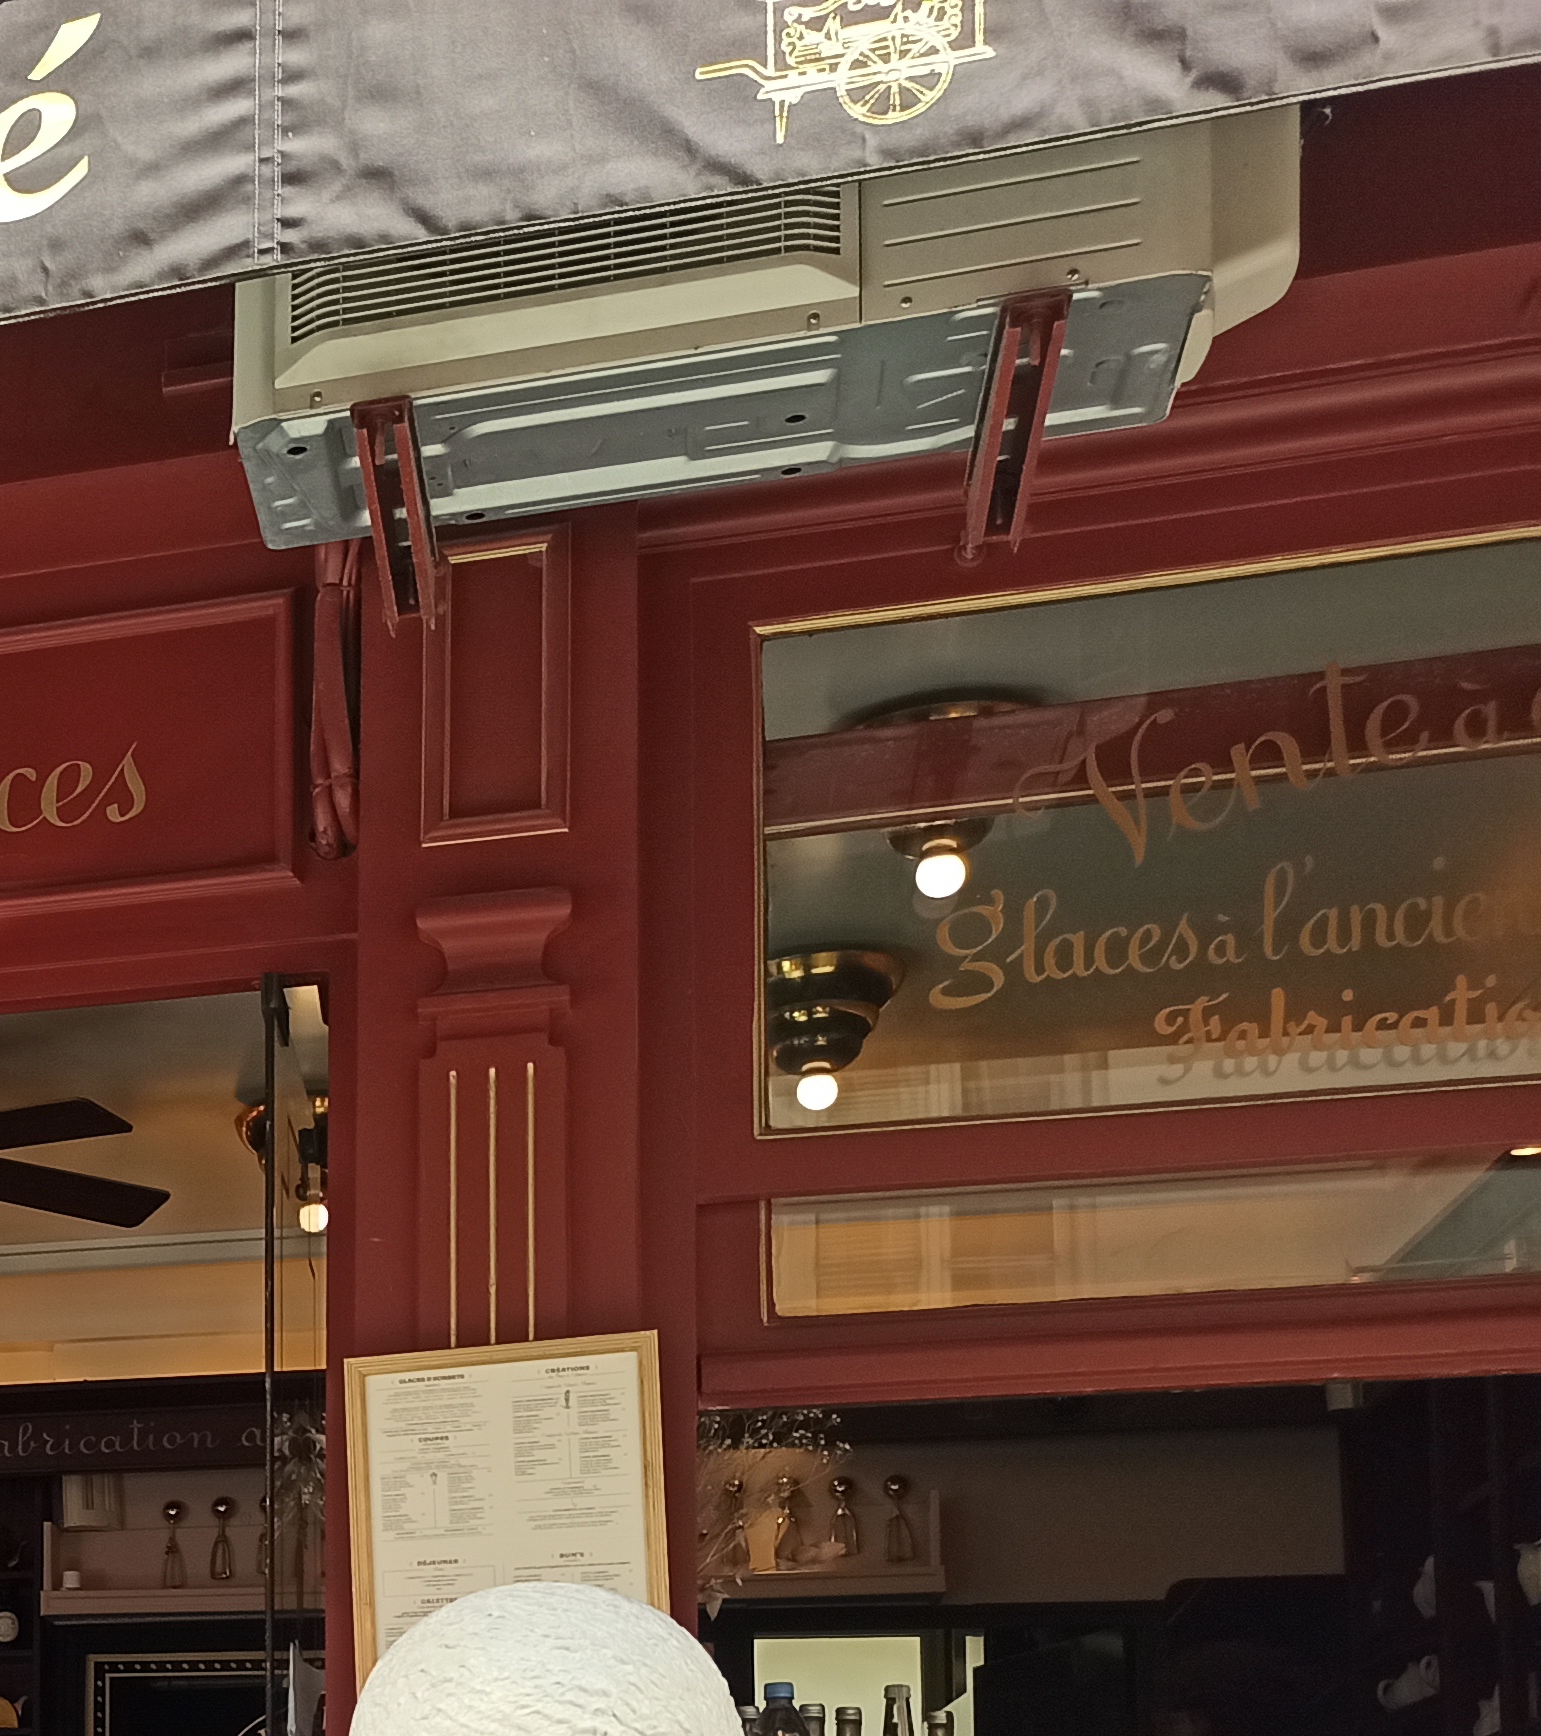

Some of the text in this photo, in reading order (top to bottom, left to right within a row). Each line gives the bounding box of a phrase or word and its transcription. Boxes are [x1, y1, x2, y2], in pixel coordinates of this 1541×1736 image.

[1013, 661, 1507, 867] Vente à
[1207, 915, 1245, 965] à
